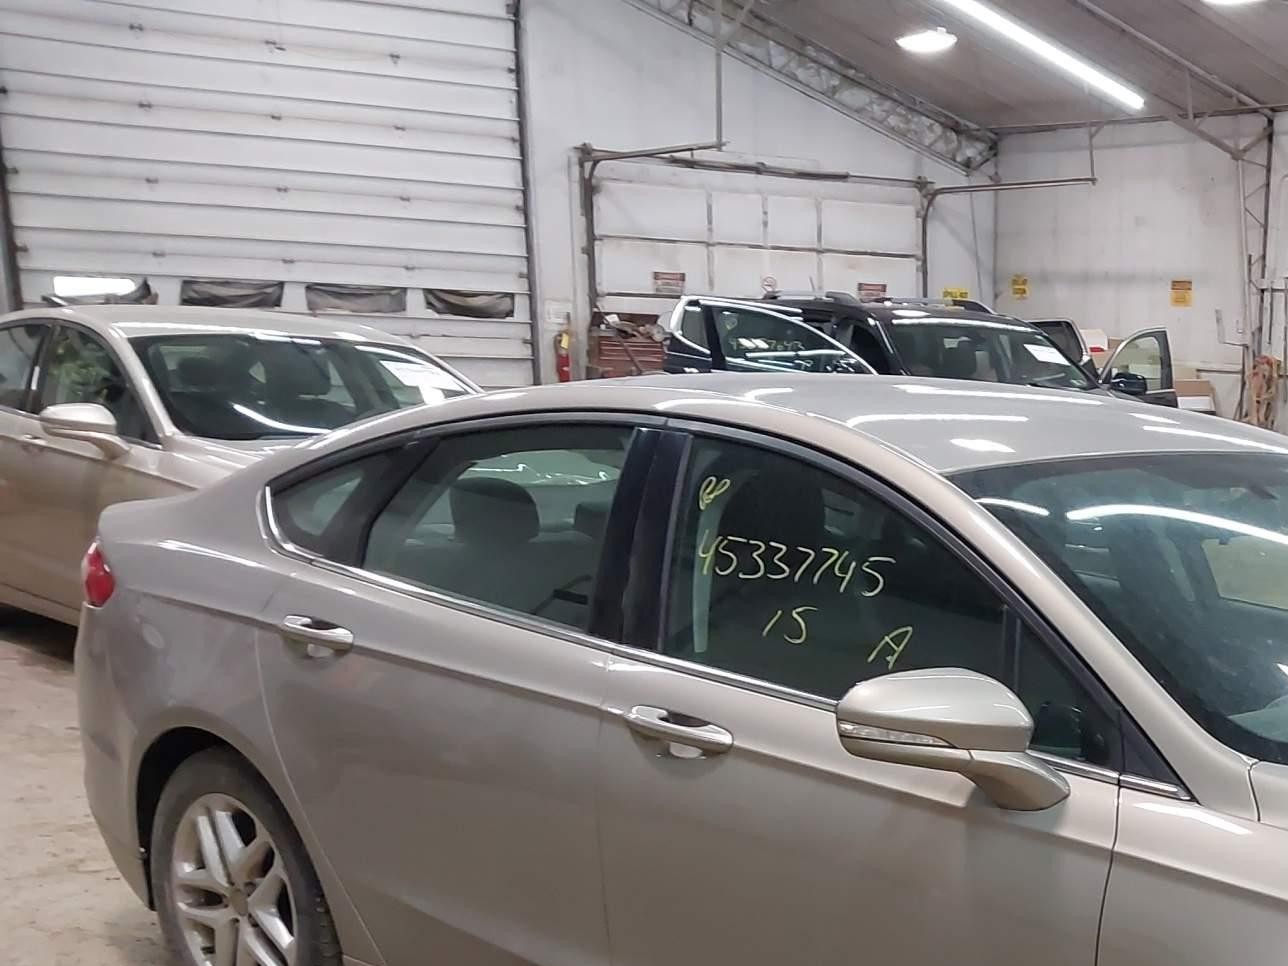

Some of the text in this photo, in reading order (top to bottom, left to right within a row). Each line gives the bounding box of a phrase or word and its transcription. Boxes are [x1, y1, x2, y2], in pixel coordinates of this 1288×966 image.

[698, 530, 896, 597] 45337745
[762, 606, 913, 670] 15 A
